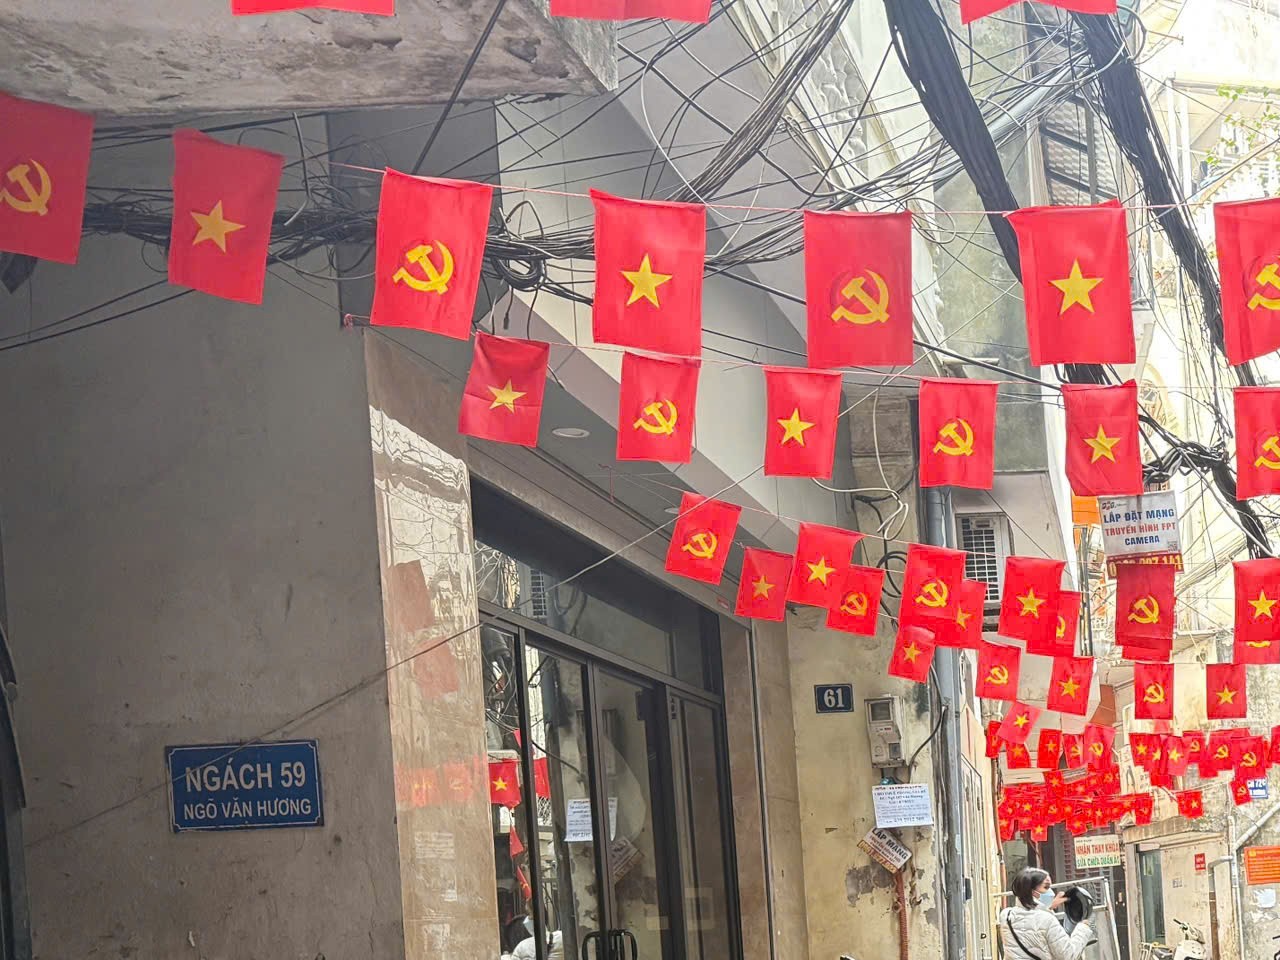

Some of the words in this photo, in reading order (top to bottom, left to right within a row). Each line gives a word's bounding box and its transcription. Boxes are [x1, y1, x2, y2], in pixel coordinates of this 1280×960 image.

[1146, 508, 1174, 520] MẠNG
[1162, 522, 1176, 530] FPT
[1125, 535, 1160, 546] CAMERA
[823, 688, 845, 708] 61
[185, 757, 272, 792] NGÁCH
[281, 761, 306, 788] 59
[184, 798, 217, 820] NGÕ
[221, 796, 253, 818] VĂN
[257, 797, 312, 816] HƯƠNG
